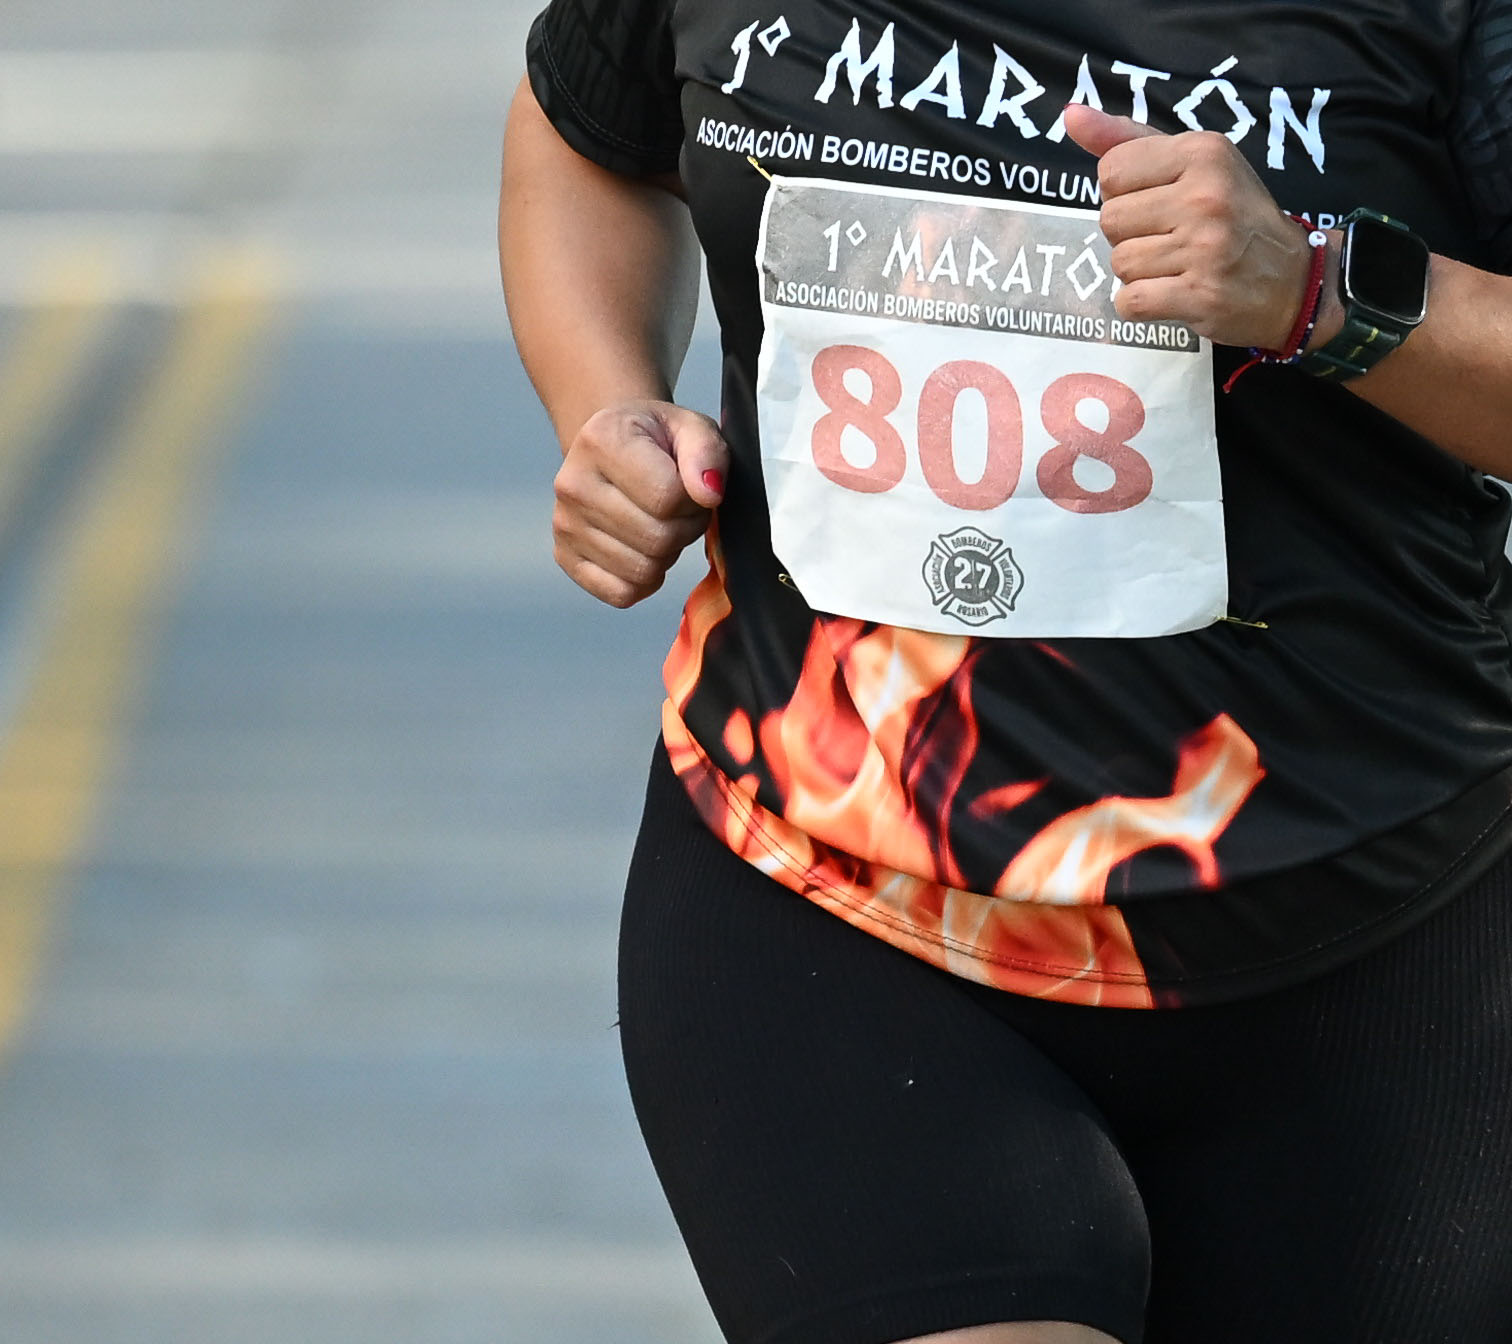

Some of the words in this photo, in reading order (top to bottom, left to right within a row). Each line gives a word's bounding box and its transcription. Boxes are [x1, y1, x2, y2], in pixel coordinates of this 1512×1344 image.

[814, 16, 1332, 175] MARATÓN
[696, 117, 814, 161] ASOCIACIÓN
[821, 135, 991, 186] BOMBEROS
[882, 225, 1122, 302] MARATÓ
[775, 280, 879, 314] ASOCIACIÓN
[884, 293, 980, 325] BOMBEROS
[986, 306, 1106, 340] VOLUNTARIOS
[1110, 321, 1190, 348] ROSARIO
[811, 344, 1154, 514] 808
[954, 556, 992, 589] 27
